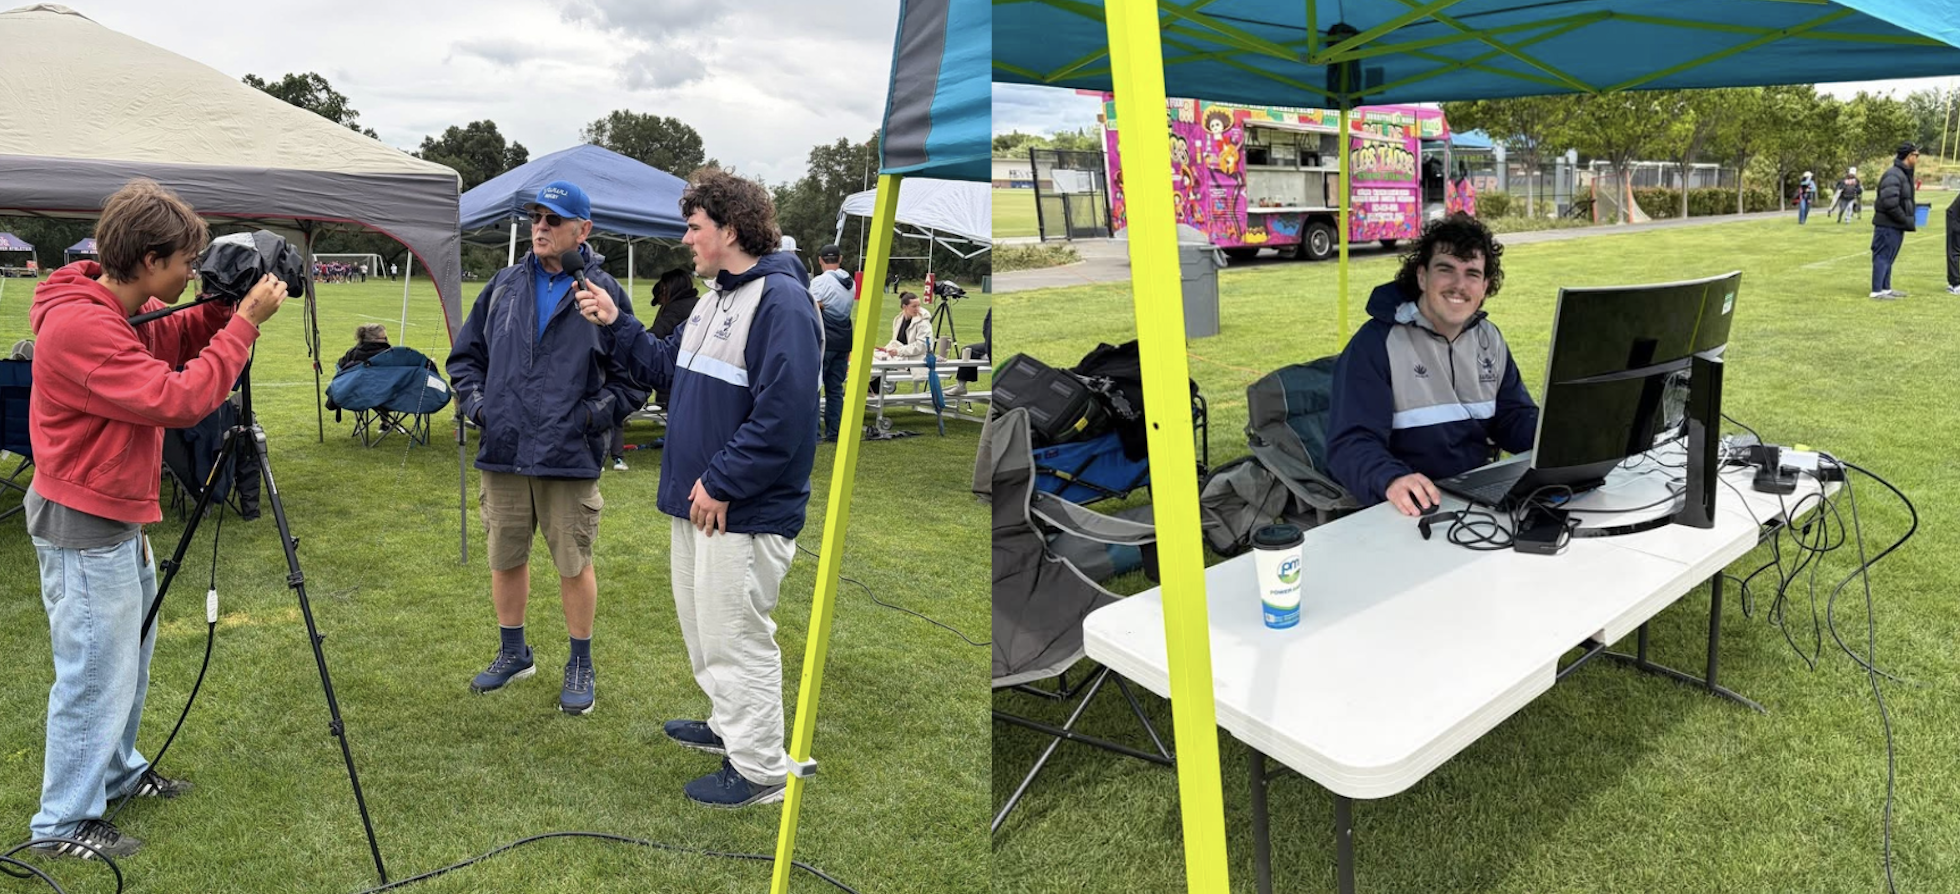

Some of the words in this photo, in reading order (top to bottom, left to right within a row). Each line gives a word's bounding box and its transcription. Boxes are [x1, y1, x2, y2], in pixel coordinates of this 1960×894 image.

[1351, 146, 1377, 173] LOS
[1377, 147, 1416, 175] TACOS
[1281, 559, 1300, 576] pm
